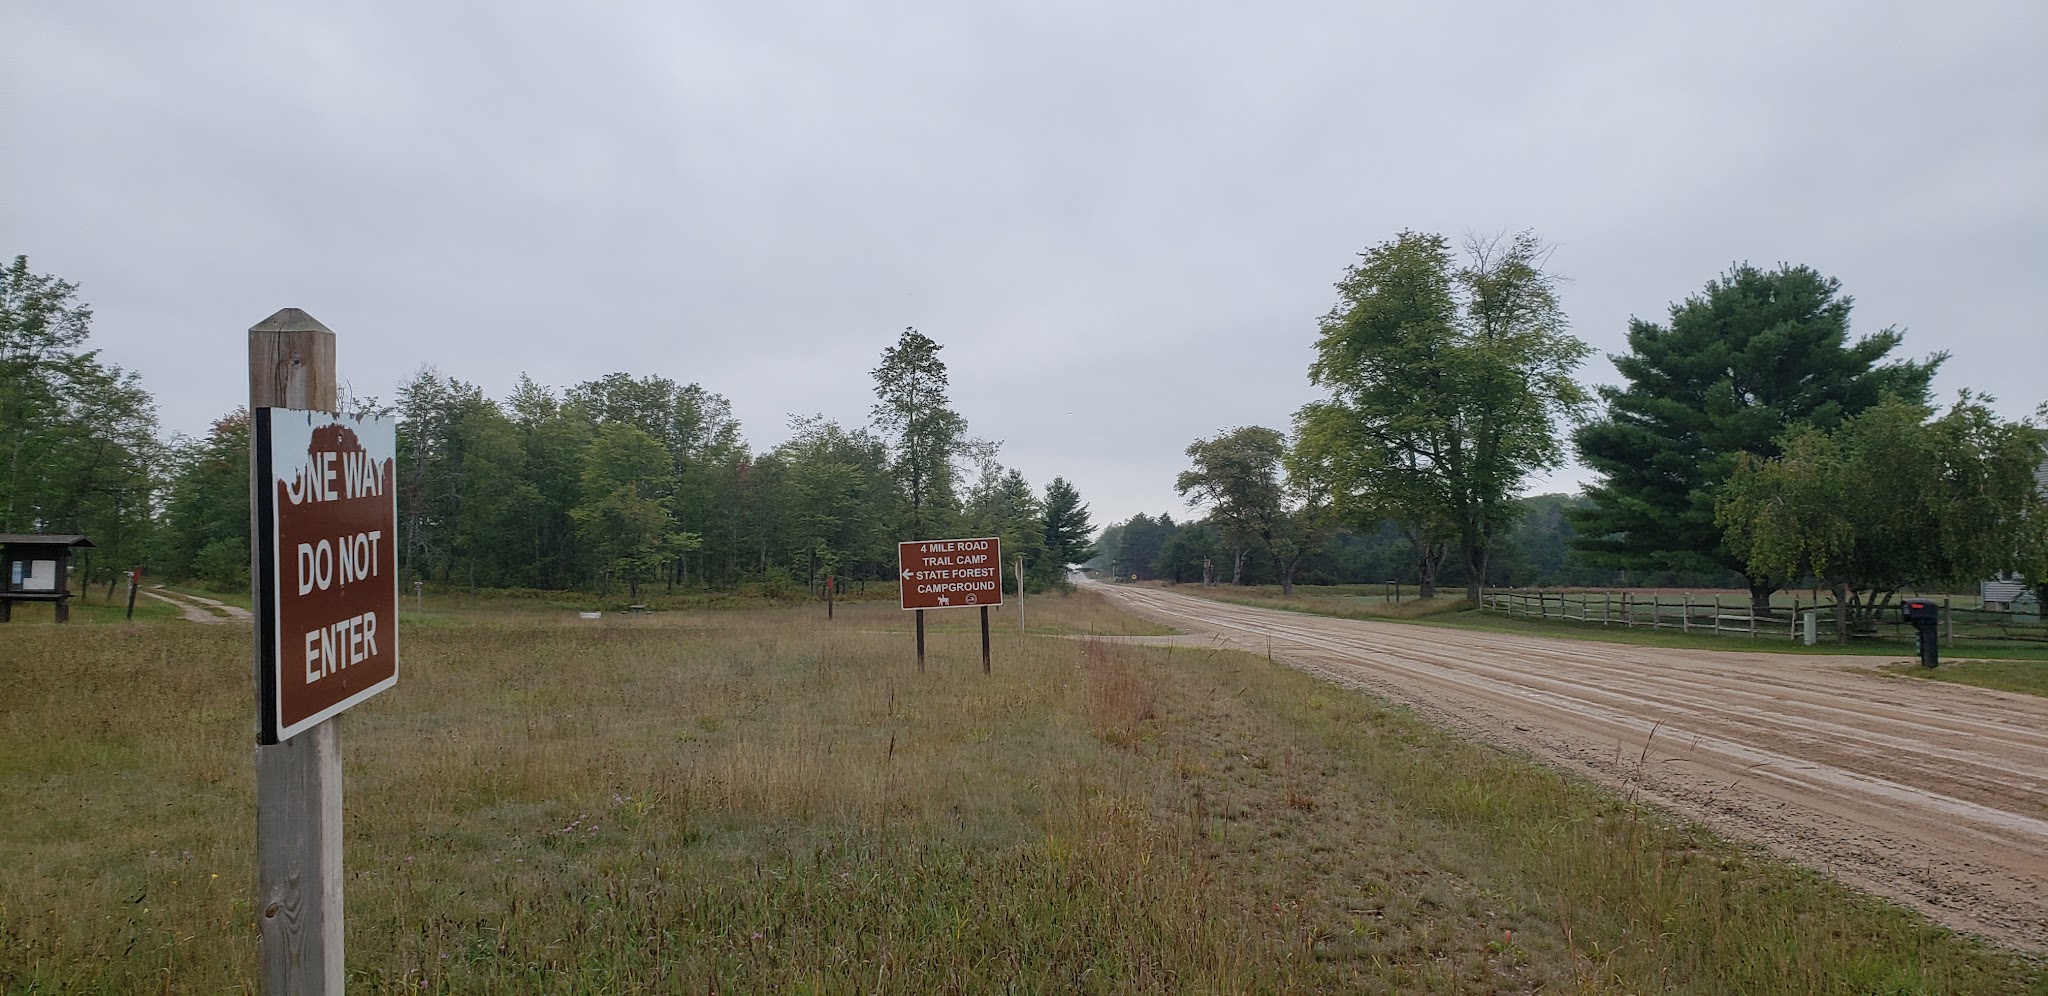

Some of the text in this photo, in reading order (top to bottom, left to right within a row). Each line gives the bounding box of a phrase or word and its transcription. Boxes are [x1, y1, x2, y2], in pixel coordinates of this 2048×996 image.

[343, 450, 385, 499] WAY
[920, 541, 988, 553] 4 MILE ROAD
[297, 530, 381, 596] DO NOT
[922, 554, 987, 566] TRAIL CAMP
[916, 567, 995, 580] STATE FOREST
[917, 581, 995, 593] CAMPGROUND
[305, 611, 378, 685] ENTER
